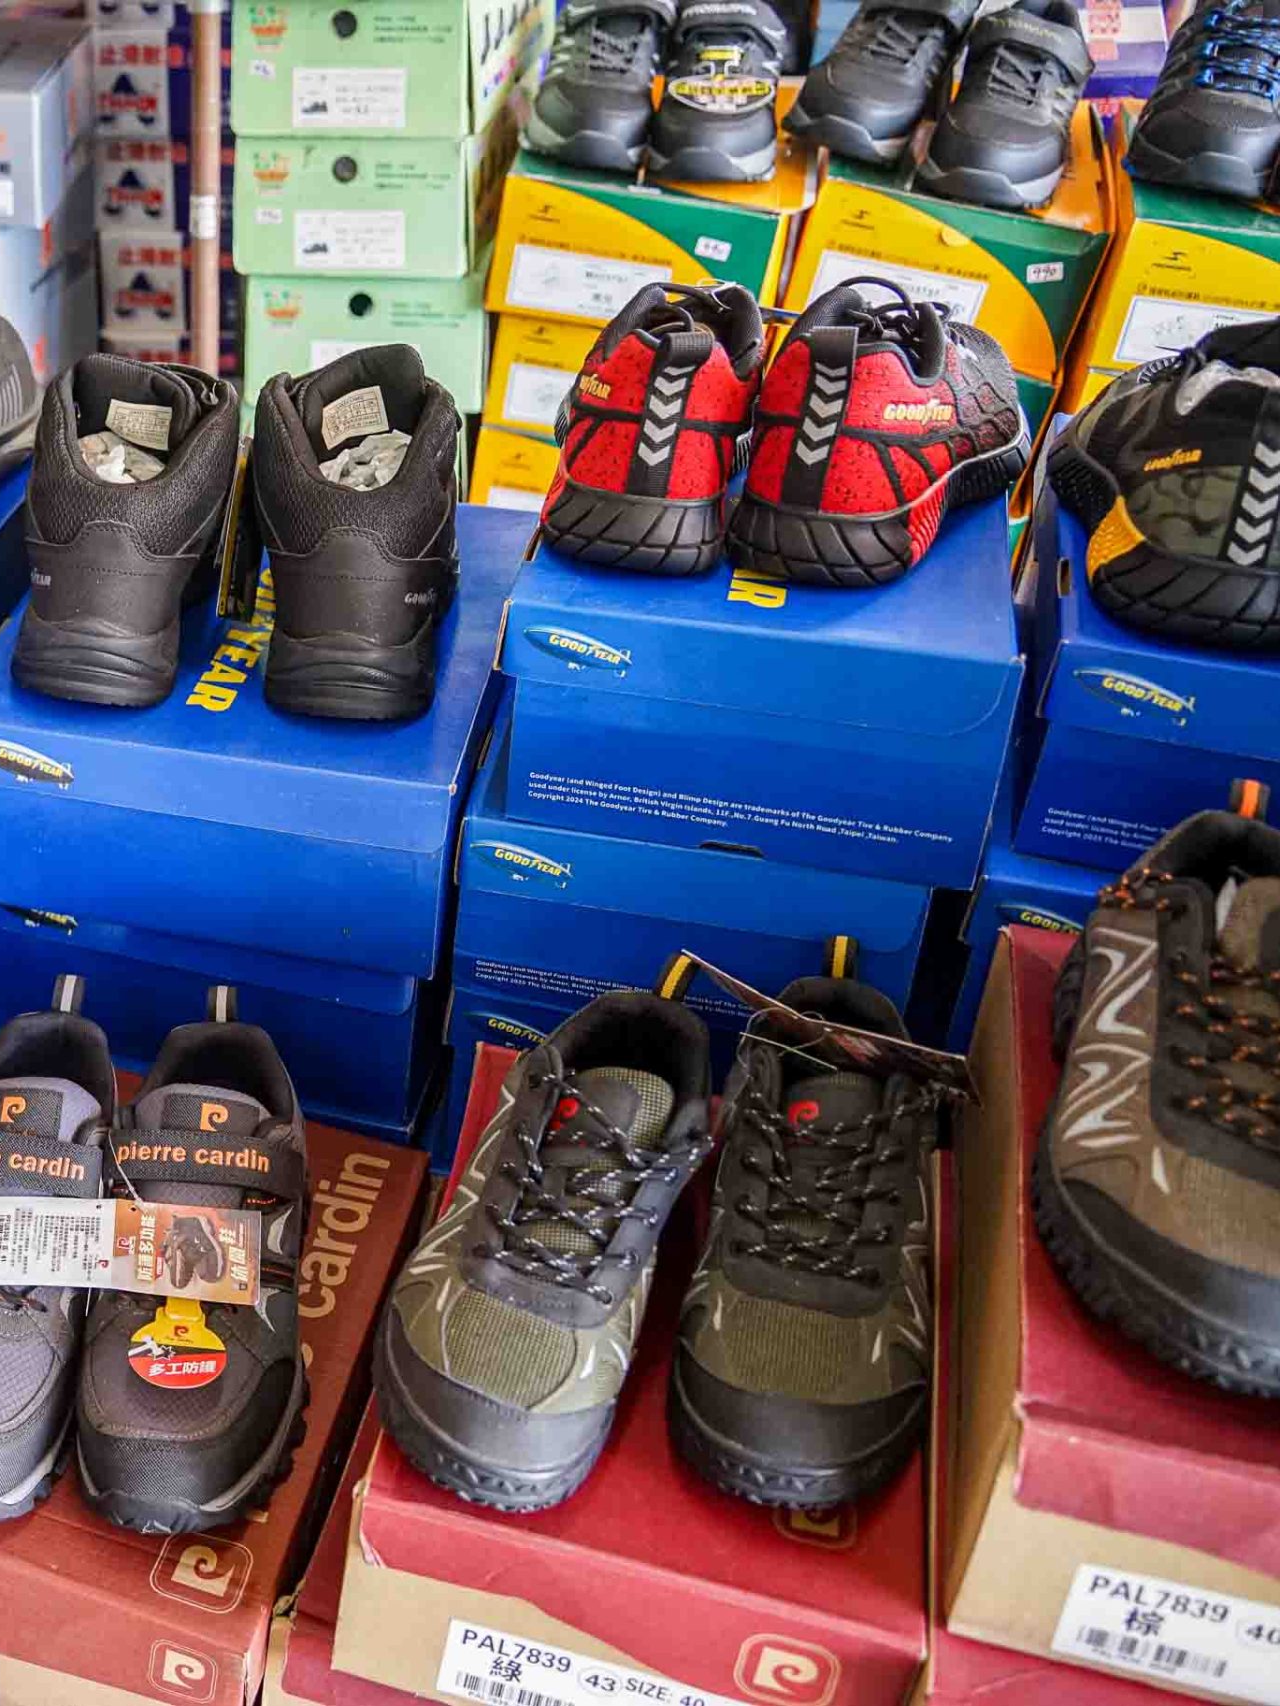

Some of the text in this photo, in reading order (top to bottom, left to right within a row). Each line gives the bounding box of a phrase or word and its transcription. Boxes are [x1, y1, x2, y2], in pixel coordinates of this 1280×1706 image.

[883, 398, 953, 425] GOODYEAR
[548, 634, 621, 666] GOODYEAR
[1101, 675, 1183, 713] GOODYEAR
[528, 790, 565, 802] Copyright
[585, 798, 599, 806] The
[600, 801, 636, 813] Goodyear
[638, 806, 652, 815] Tire
[661, 810, 688, 820] Rubber
[528, 781, 546, 790] used
[548, 784, 570, 793] under
[571, 787, 597, 797] license
[598, 790, 608, 799] by
[634, 796, 659, 806] British
[660, 800, 683, 811] Virgin
[780, 818, 790, 827] Fu
[792, 821, 815, 830] North
[529, 772, 565, 784] Goodyear
[585, 779, 613, 791] Winged
[614, 784, 631, 793] Foot
[663, 791, 676, 799] and
[702, 797, 728, 808] Design
[730, 802, 743, 810] are
[744, 804, 790, 817] trademarks
[802, 812, 816, 821] The
[818, 815, 856, 827] Goodyear
[858, 820, 873, 830] Tire
[883, 825, 912, 836] Rubber
[914, 830, 953, 843] Company
[494, 847, 563, 877] GOODYEAR
[8, 1151, 86, 1182] cardin
[116, 1141, 271, 1173] pierre cardin
[299, 1150, 392, 1319] cardin
[148, 1360, 217, 1377] 多工防護
[1089, 1574, 1229, 1623] PAL7839
[1124, 1606, 1165, 1637] 棕
[462, 1629, 572, 1673] PAL7839
[584, 1672, 618, 1693] 43
[625, 1677, 673, 1703] SIZE:
[489, 1656, 522, 1683] 綠
